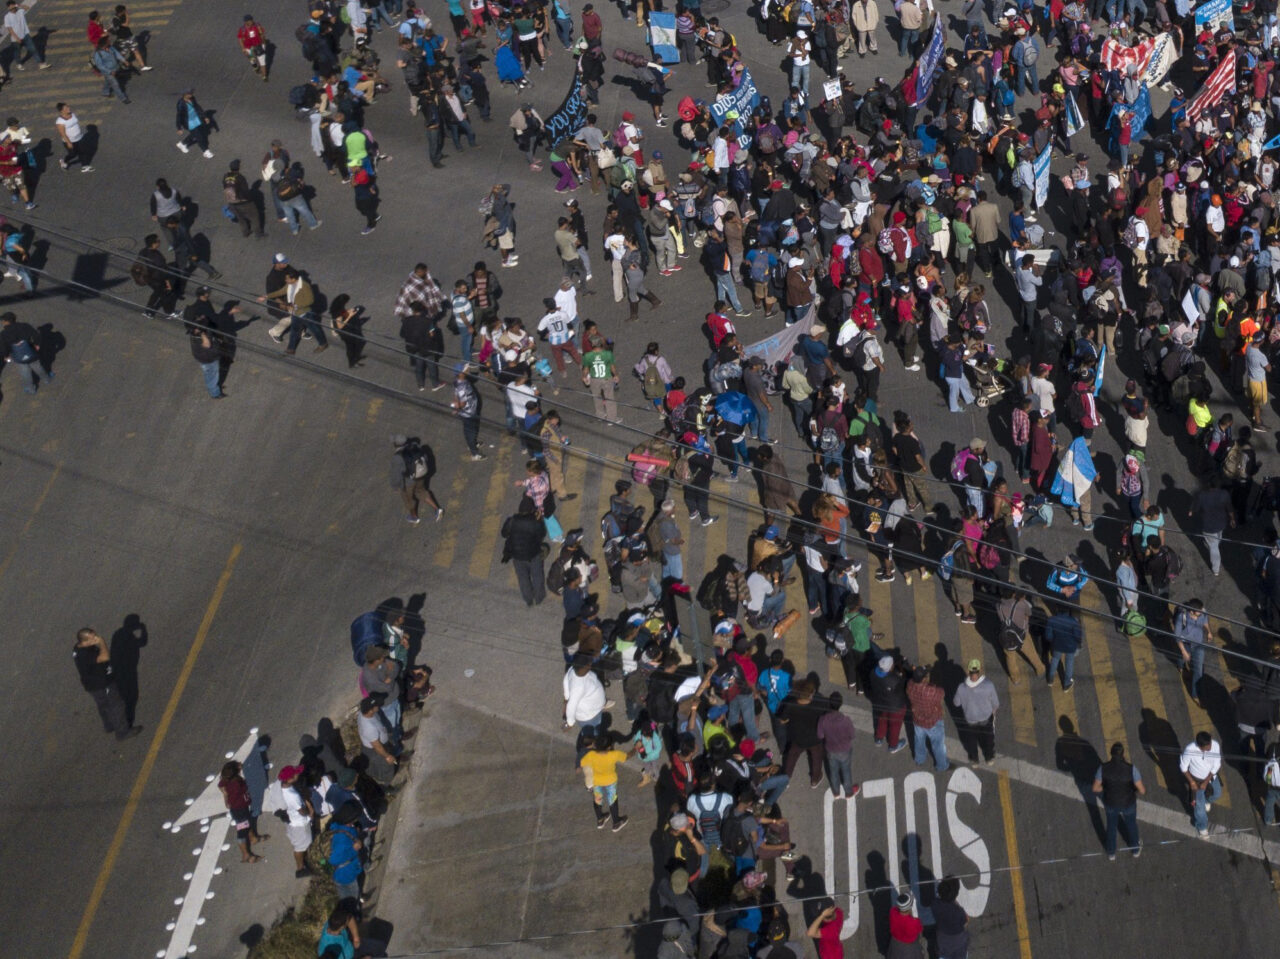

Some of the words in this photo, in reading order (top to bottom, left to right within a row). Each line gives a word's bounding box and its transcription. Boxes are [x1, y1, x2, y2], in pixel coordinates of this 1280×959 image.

[712, 95, 737, 117] DIOS
[552, 320, 564, 333] 10
[593, 363, 606, 378] 10
[824, 766, 991, 941] SOLO
